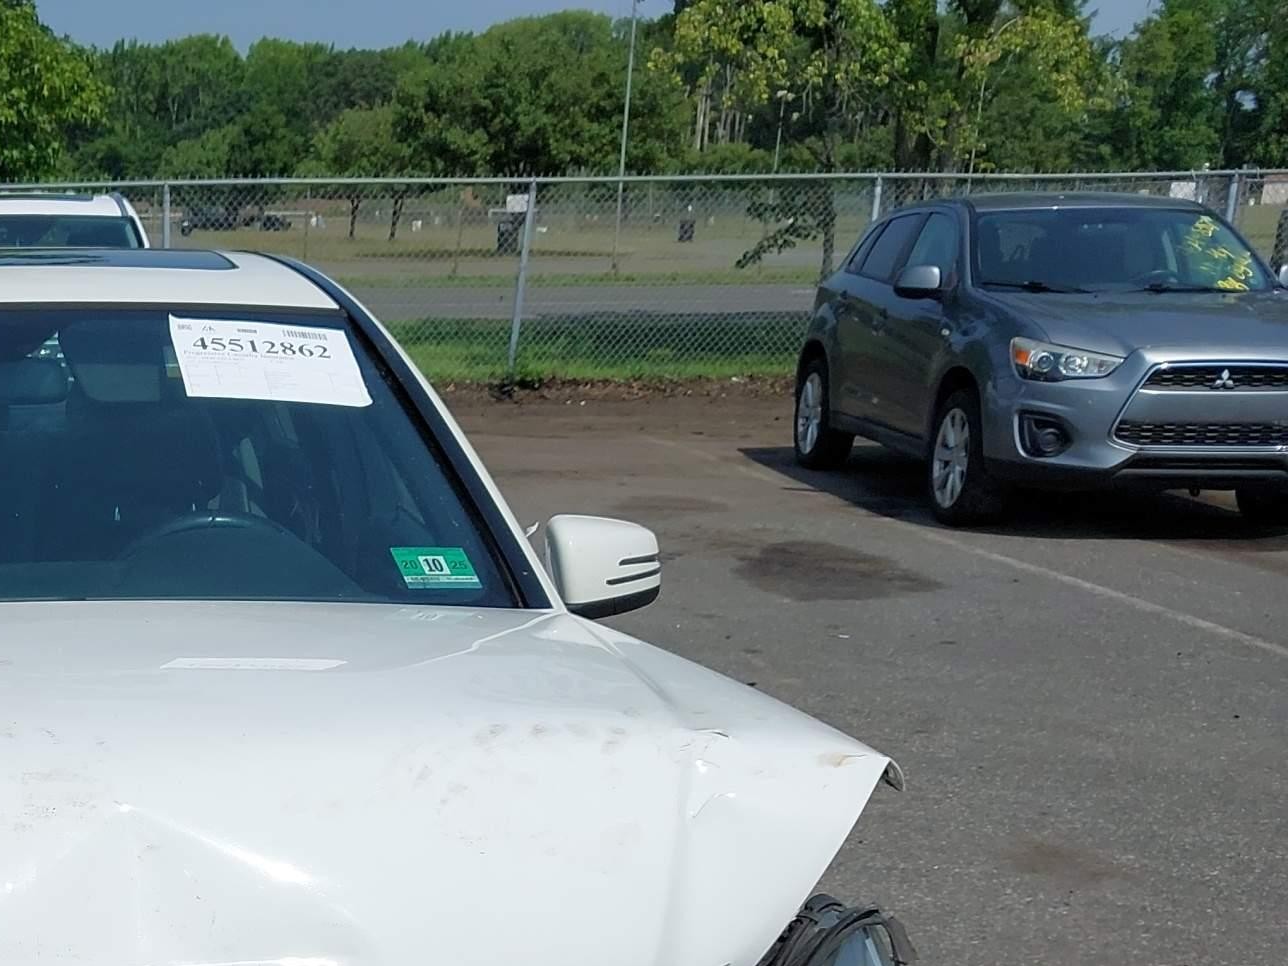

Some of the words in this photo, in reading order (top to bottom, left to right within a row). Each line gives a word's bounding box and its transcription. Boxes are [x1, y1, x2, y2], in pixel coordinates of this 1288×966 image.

[192, 336, 331, 359] 45512862
[402, 560, 418, 570] 20
[422, 557, 444, 573] 10
[450, 560, 468, 570] 25
